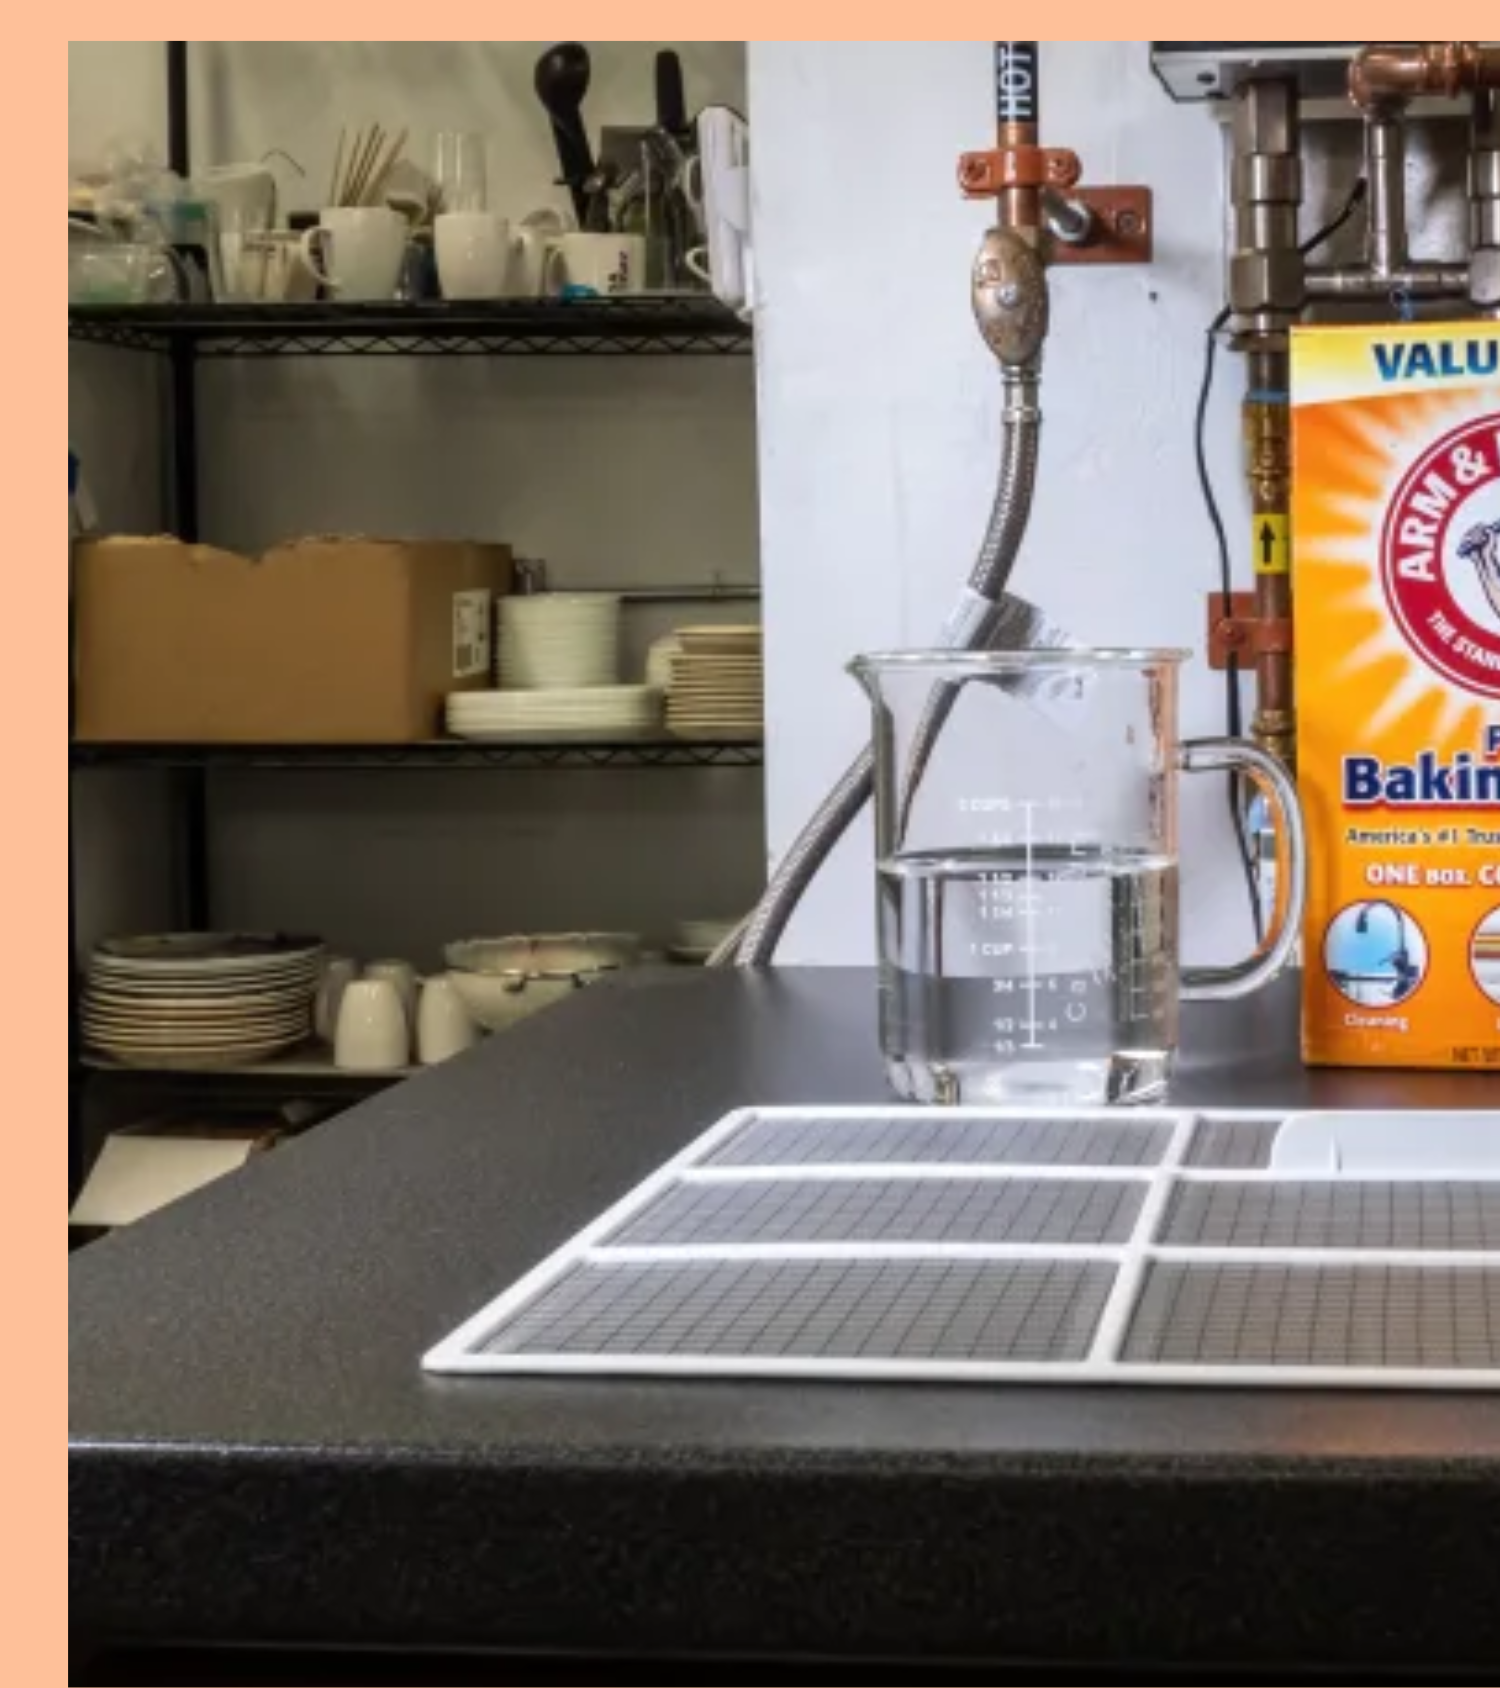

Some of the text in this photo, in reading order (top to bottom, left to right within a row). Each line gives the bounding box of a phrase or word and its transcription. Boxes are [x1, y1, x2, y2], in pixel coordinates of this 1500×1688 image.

[999, 45, 1032, 116] HOT
[1399, 478, 1450, 583] ARM
[1450, 443, 1490, 485] &
[1426, 609, 1457, 644] THE
[1346, 827, 1432, 846] America's
[1436, 828, 1458, 845] #1
[1366, 864, 1420, 886] ONE
[1344, 1013, 1409, 1033] Cleaning
